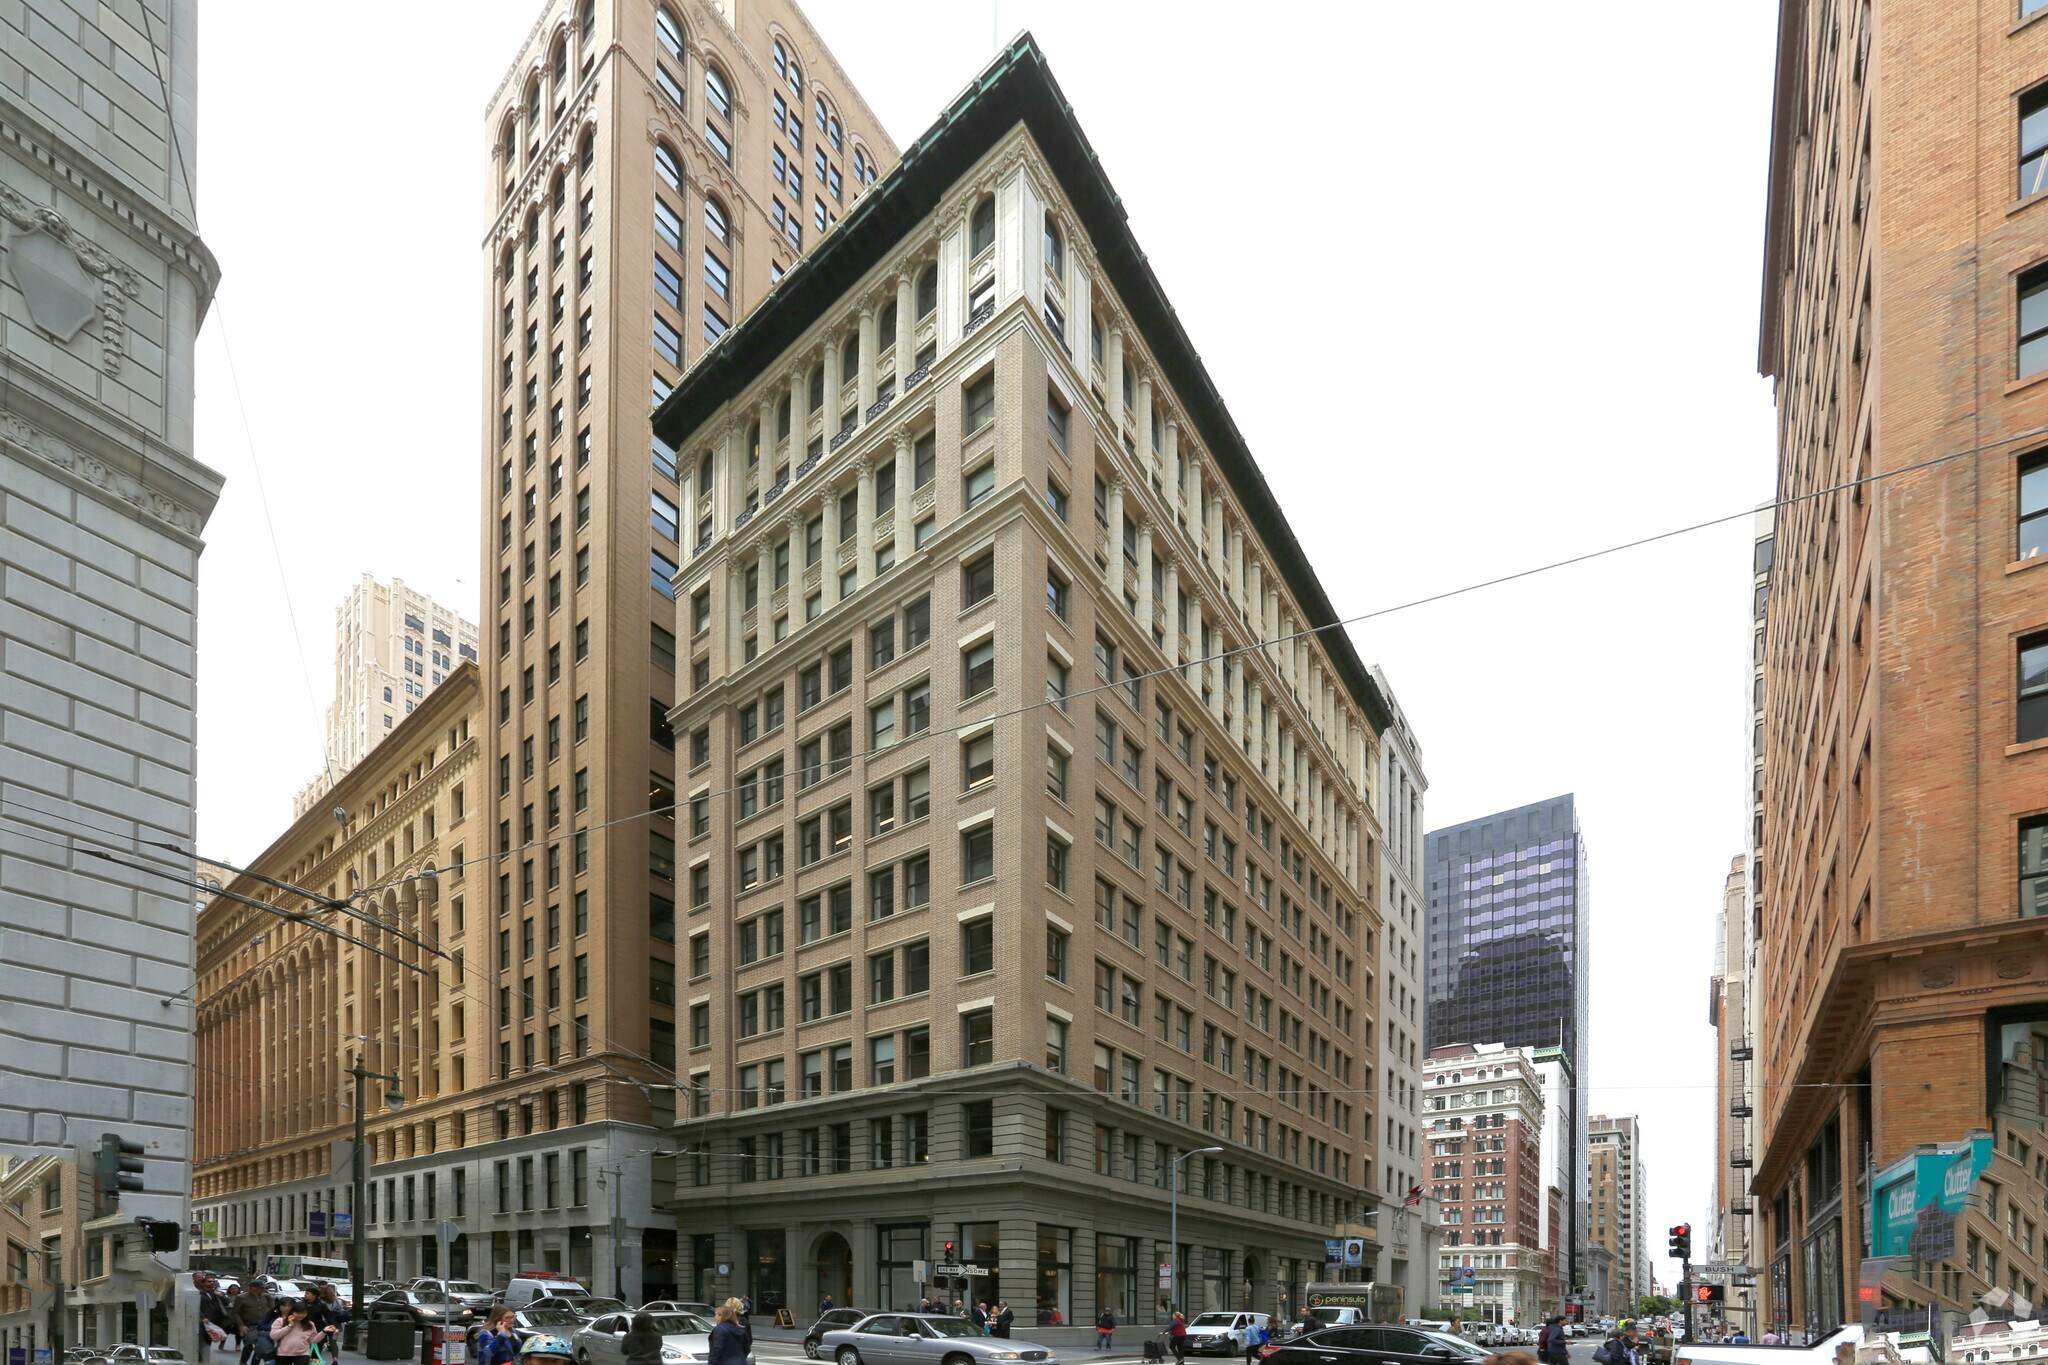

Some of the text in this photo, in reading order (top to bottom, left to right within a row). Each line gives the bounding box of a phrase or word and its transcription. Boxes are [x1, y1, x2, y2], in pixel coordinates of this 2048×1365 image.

[1944, 1165, 1972, 1197] Clutter
[1889, 1188, 1916, 1219] Clutter
[1325, 1295, 1366, 1304] peninsula
